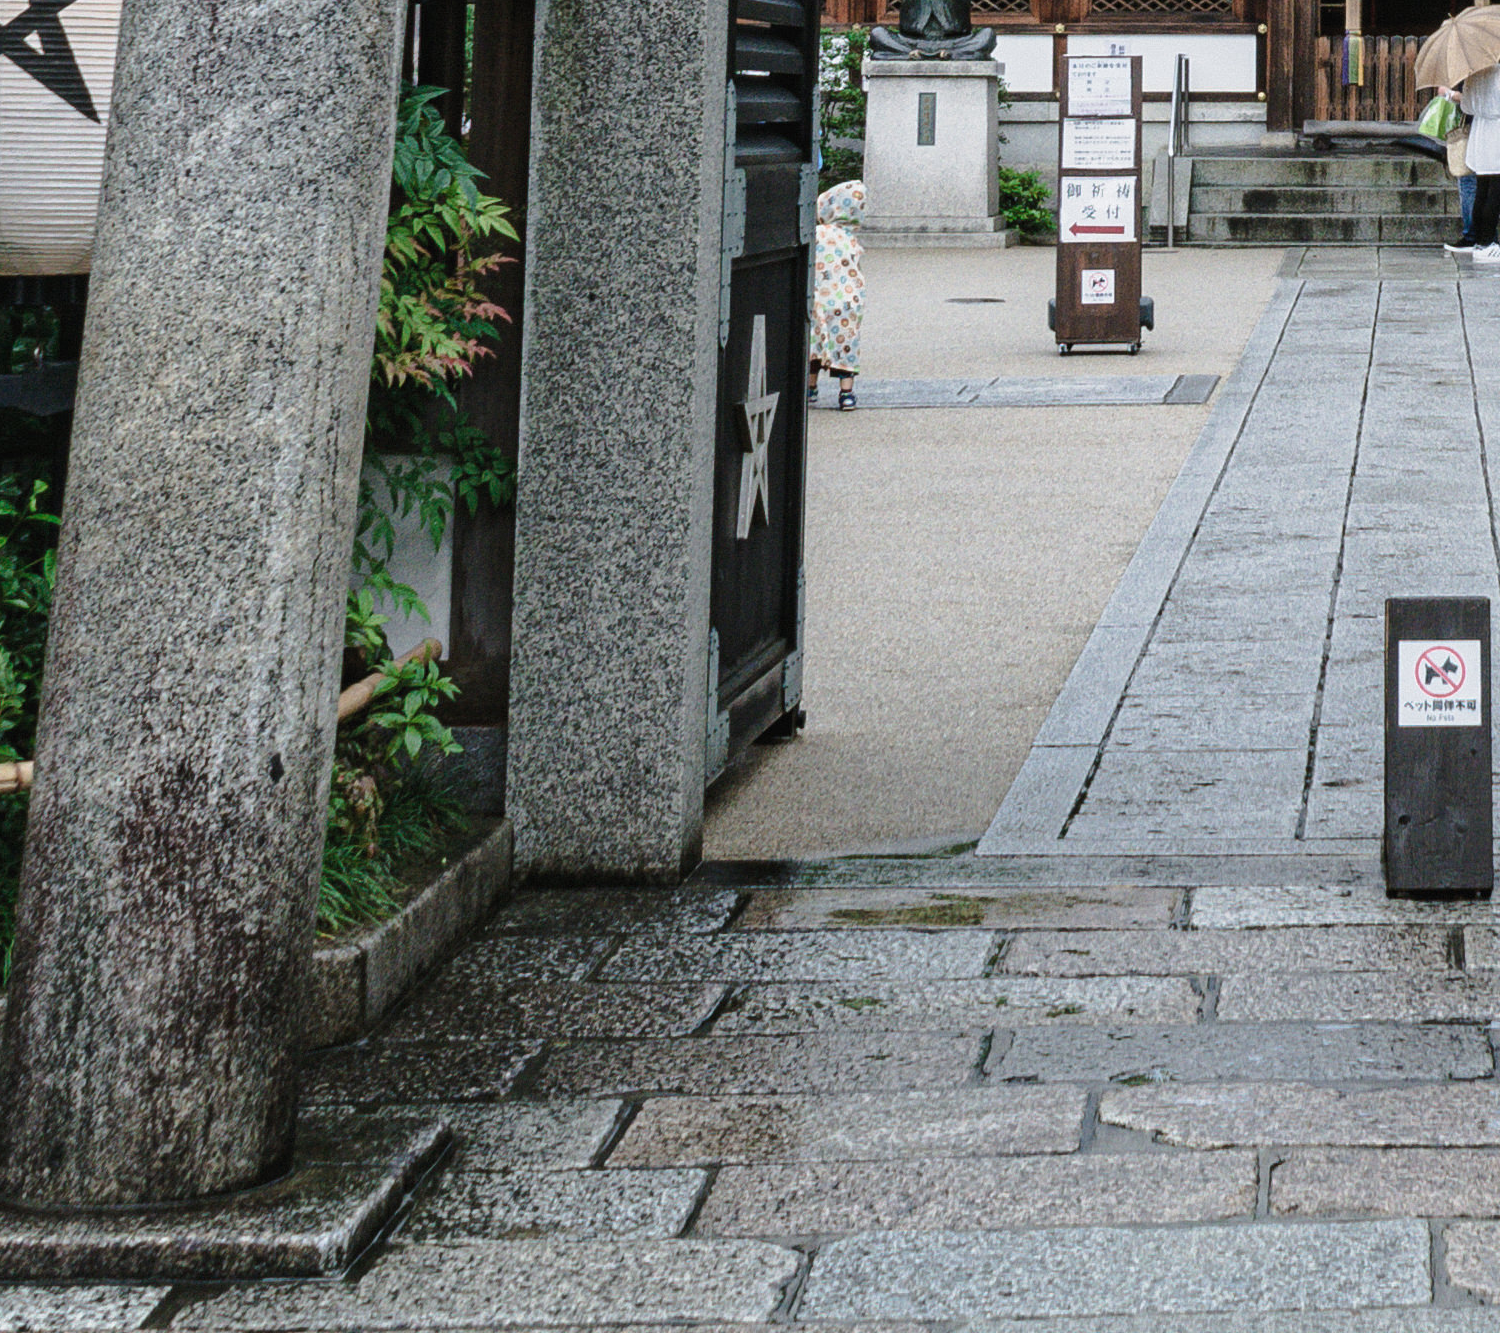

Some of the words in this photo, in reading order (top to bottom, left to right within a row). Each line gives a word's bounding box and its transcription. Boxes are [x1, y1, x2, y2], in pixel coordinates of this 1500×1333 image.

[1081, 204, 1120, 220] 受付
[1403, 699, 1477, 712] ペット同伴不可
